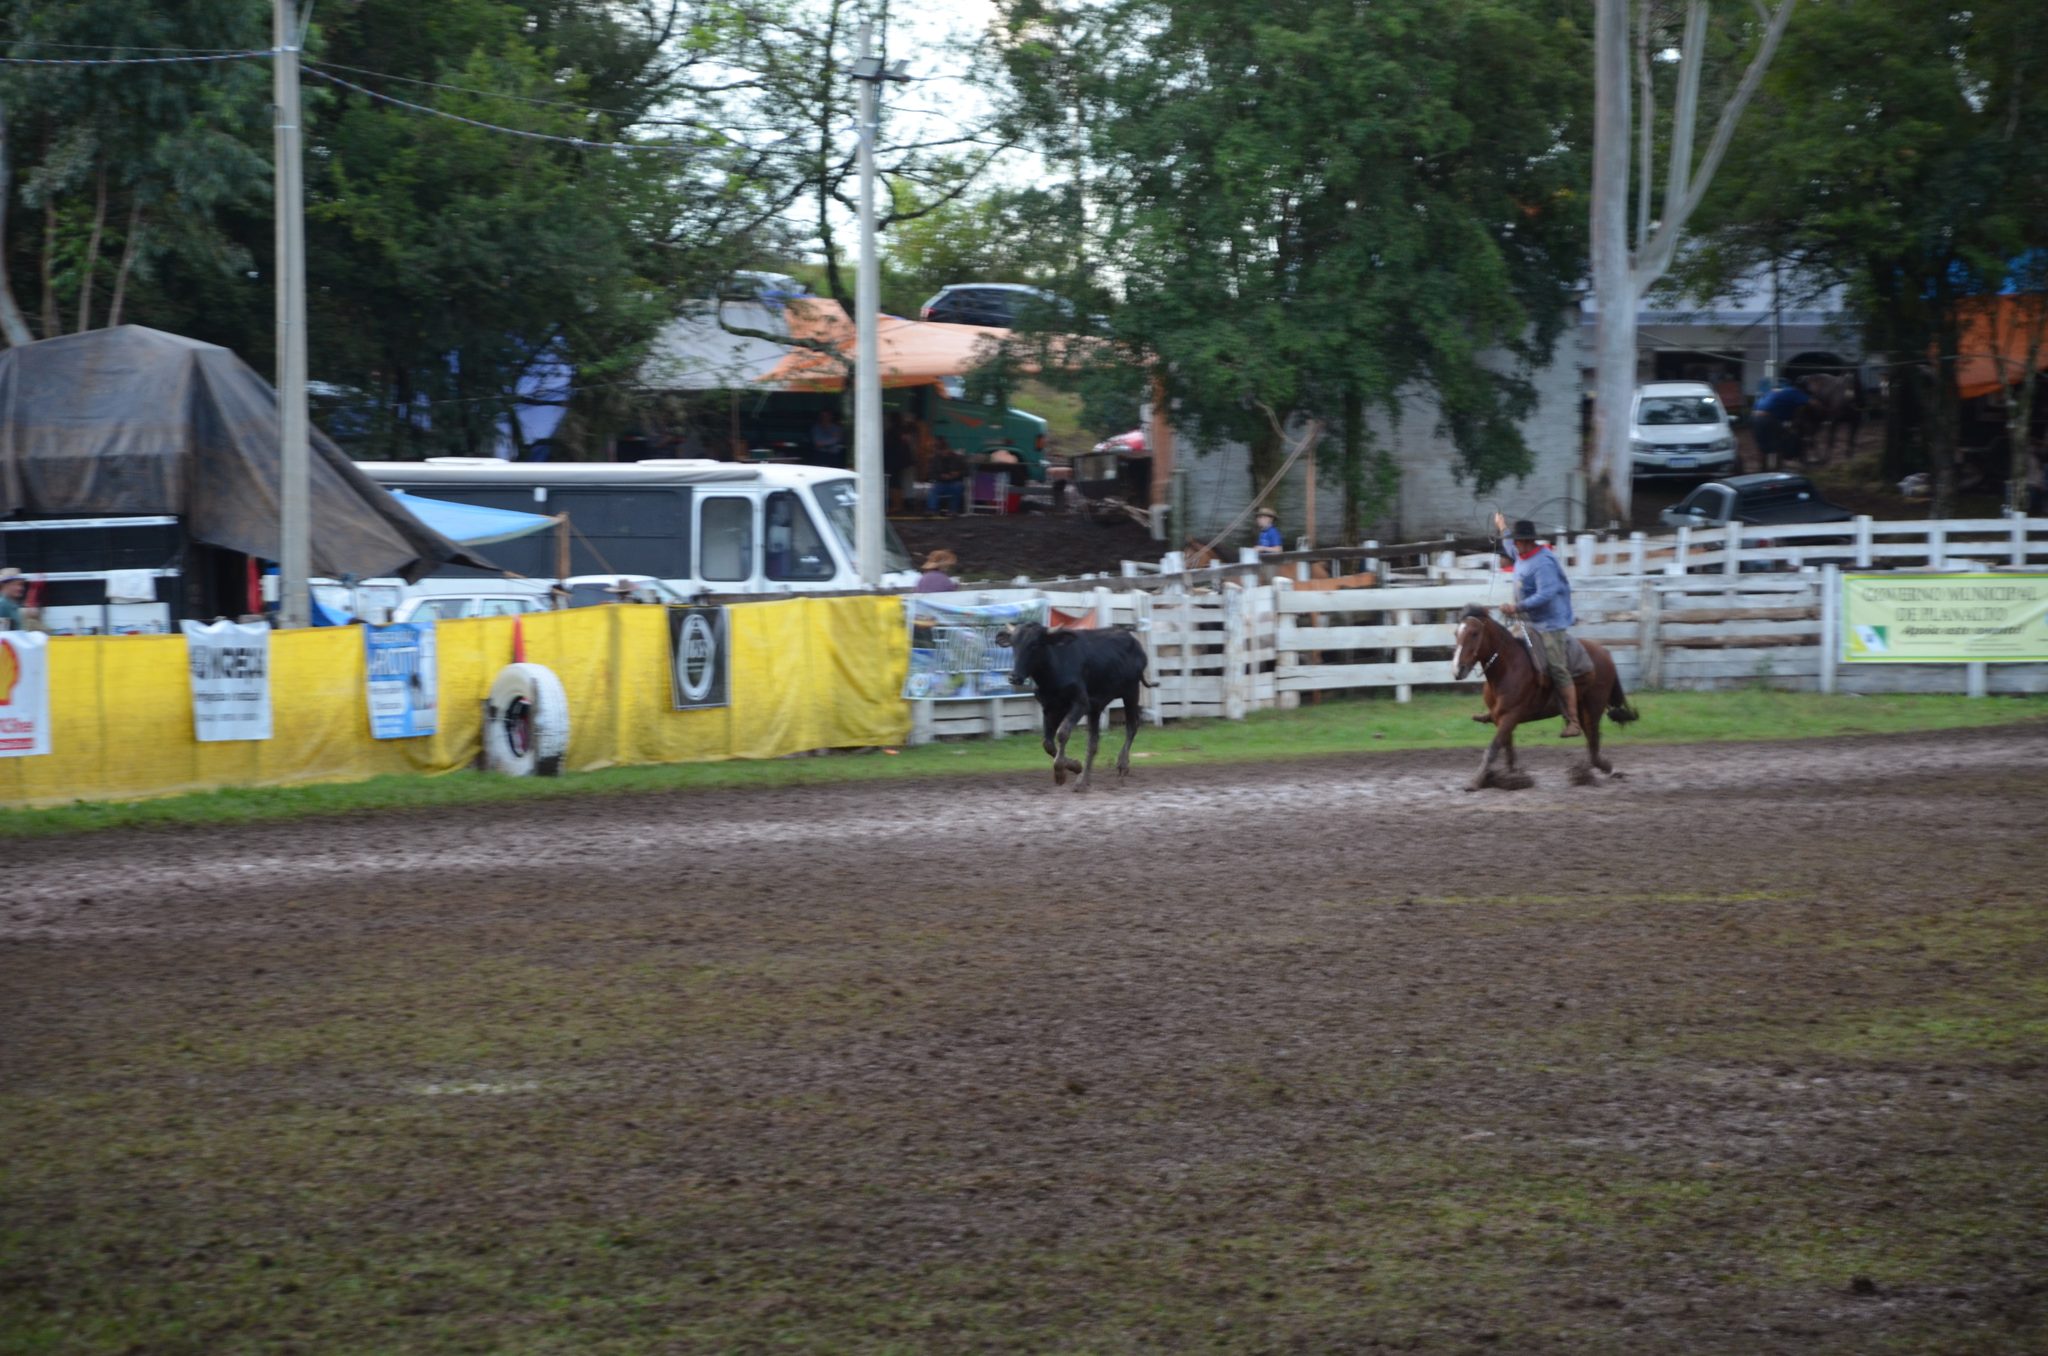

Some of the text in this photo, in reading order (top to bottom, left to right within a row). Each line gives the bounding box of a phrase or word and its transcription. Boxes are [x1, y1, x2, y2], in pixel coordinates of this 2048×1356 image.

[1863, 586, 2038, 601] GOVERNO MUNICIPAL
[1896, 607, 2008, 621] DE PLANALTO
